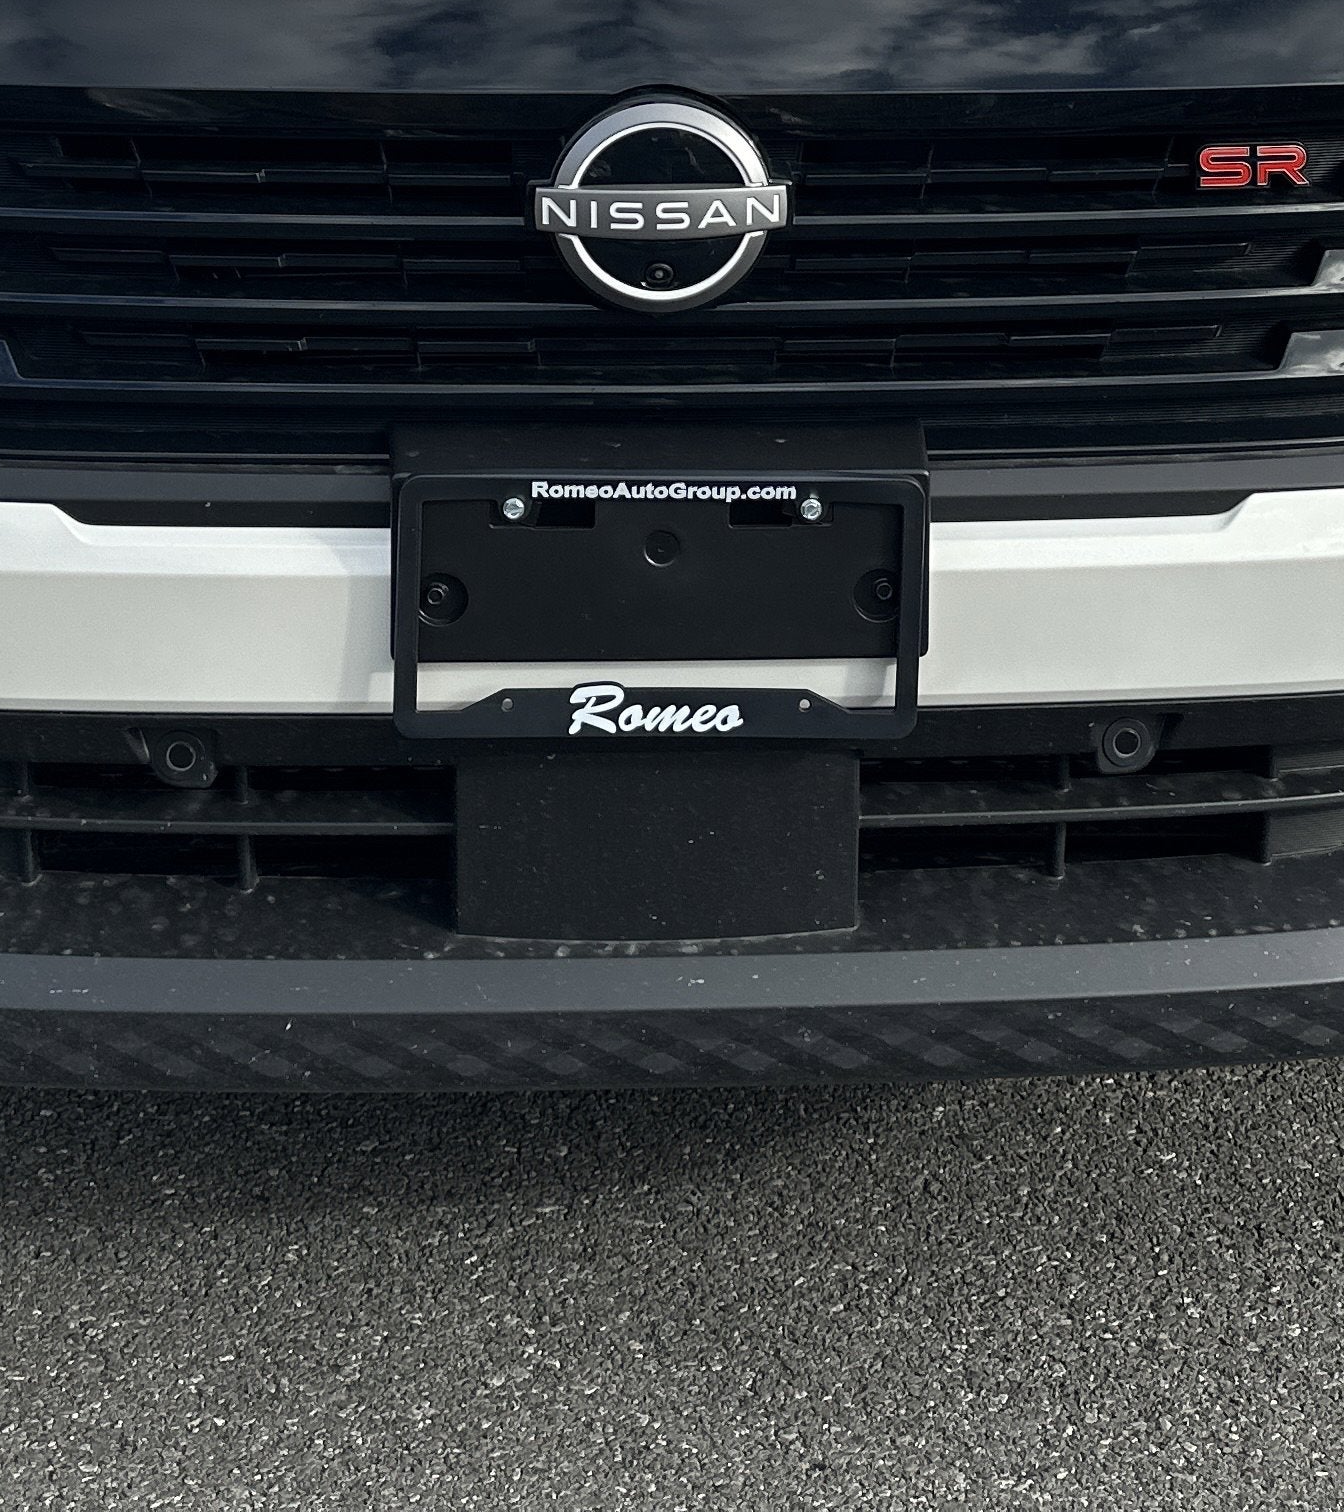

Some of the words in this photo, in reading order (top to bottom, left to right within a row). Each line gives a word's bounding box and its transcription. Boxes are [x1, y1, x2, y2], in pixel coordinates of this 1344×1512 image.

[1199, 145, 1310, 187] SR
[541, 194, 781, 231] NISSAN
[531, 480, 797, 503] RomeoAutoGroup.com
[568, 684, 744, 735] Romeo
